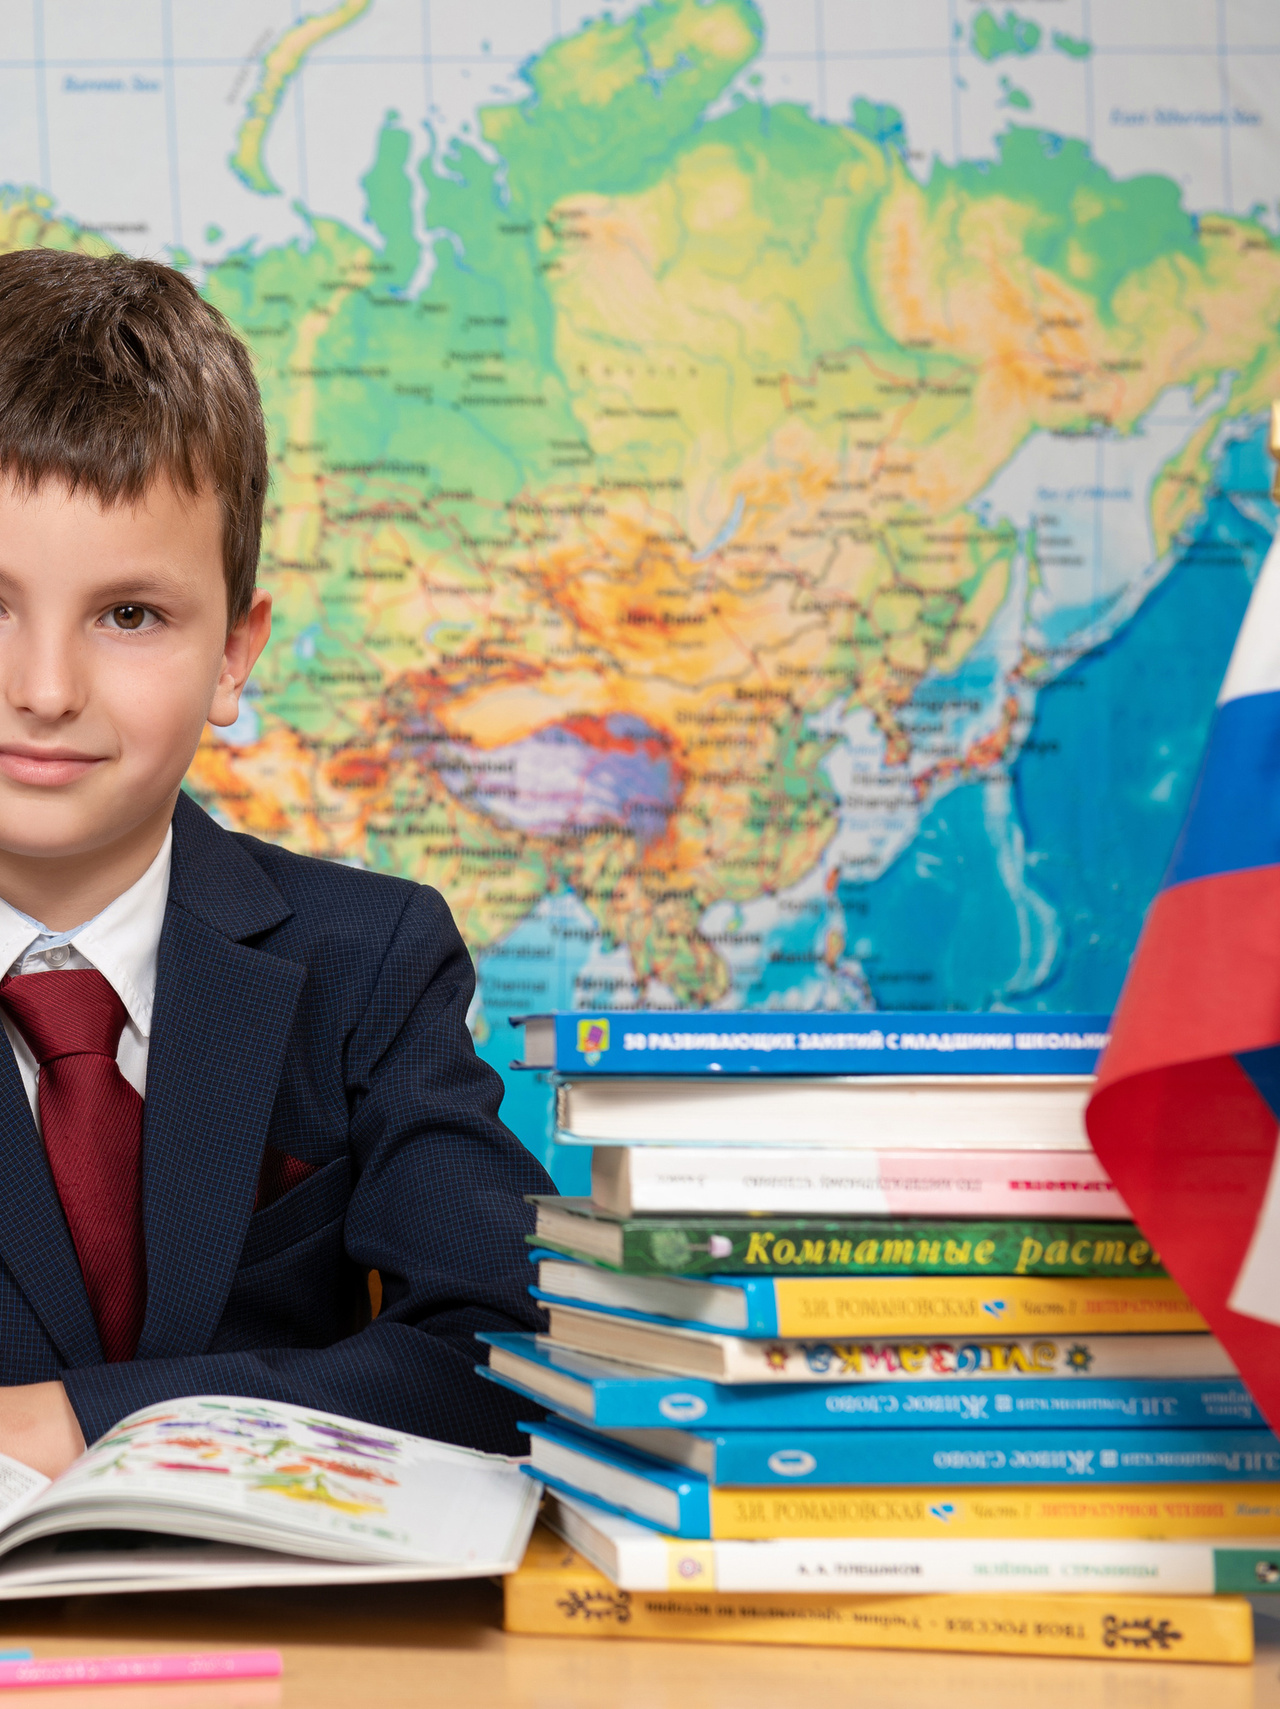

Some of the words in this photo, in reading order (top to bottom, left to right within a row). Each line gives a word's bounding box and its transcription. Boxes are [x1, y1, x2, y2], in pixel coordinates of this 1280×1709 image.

[648, 1032, 795, 1053] РАЗВИВАЮЩИХ
[798, 1029, 884, 1052] ЗАНЯТИЙ
[886, 1033, 899, 1052] С
[900, 1032, 1013, 1053] МЛАДШИМИ
[1008, 1179, 1115, 1192] АЗРАБОТКИ
[744, 1231, 997, 1265] Комнатные
[825, 1394, 899, 1414] слово
[903, 1394, 989, 1420] Живое
[933, 1450, 1007, 1469] слово
[1009, 1449, 1095, 1476] Живое
[775, 1501, 926, 1523] РОМАНОВСКАЯ
[946, 1616, 1028, 1637] РОССИЯ
[1034, 1622, 1087, 1640] ТВОЯ
